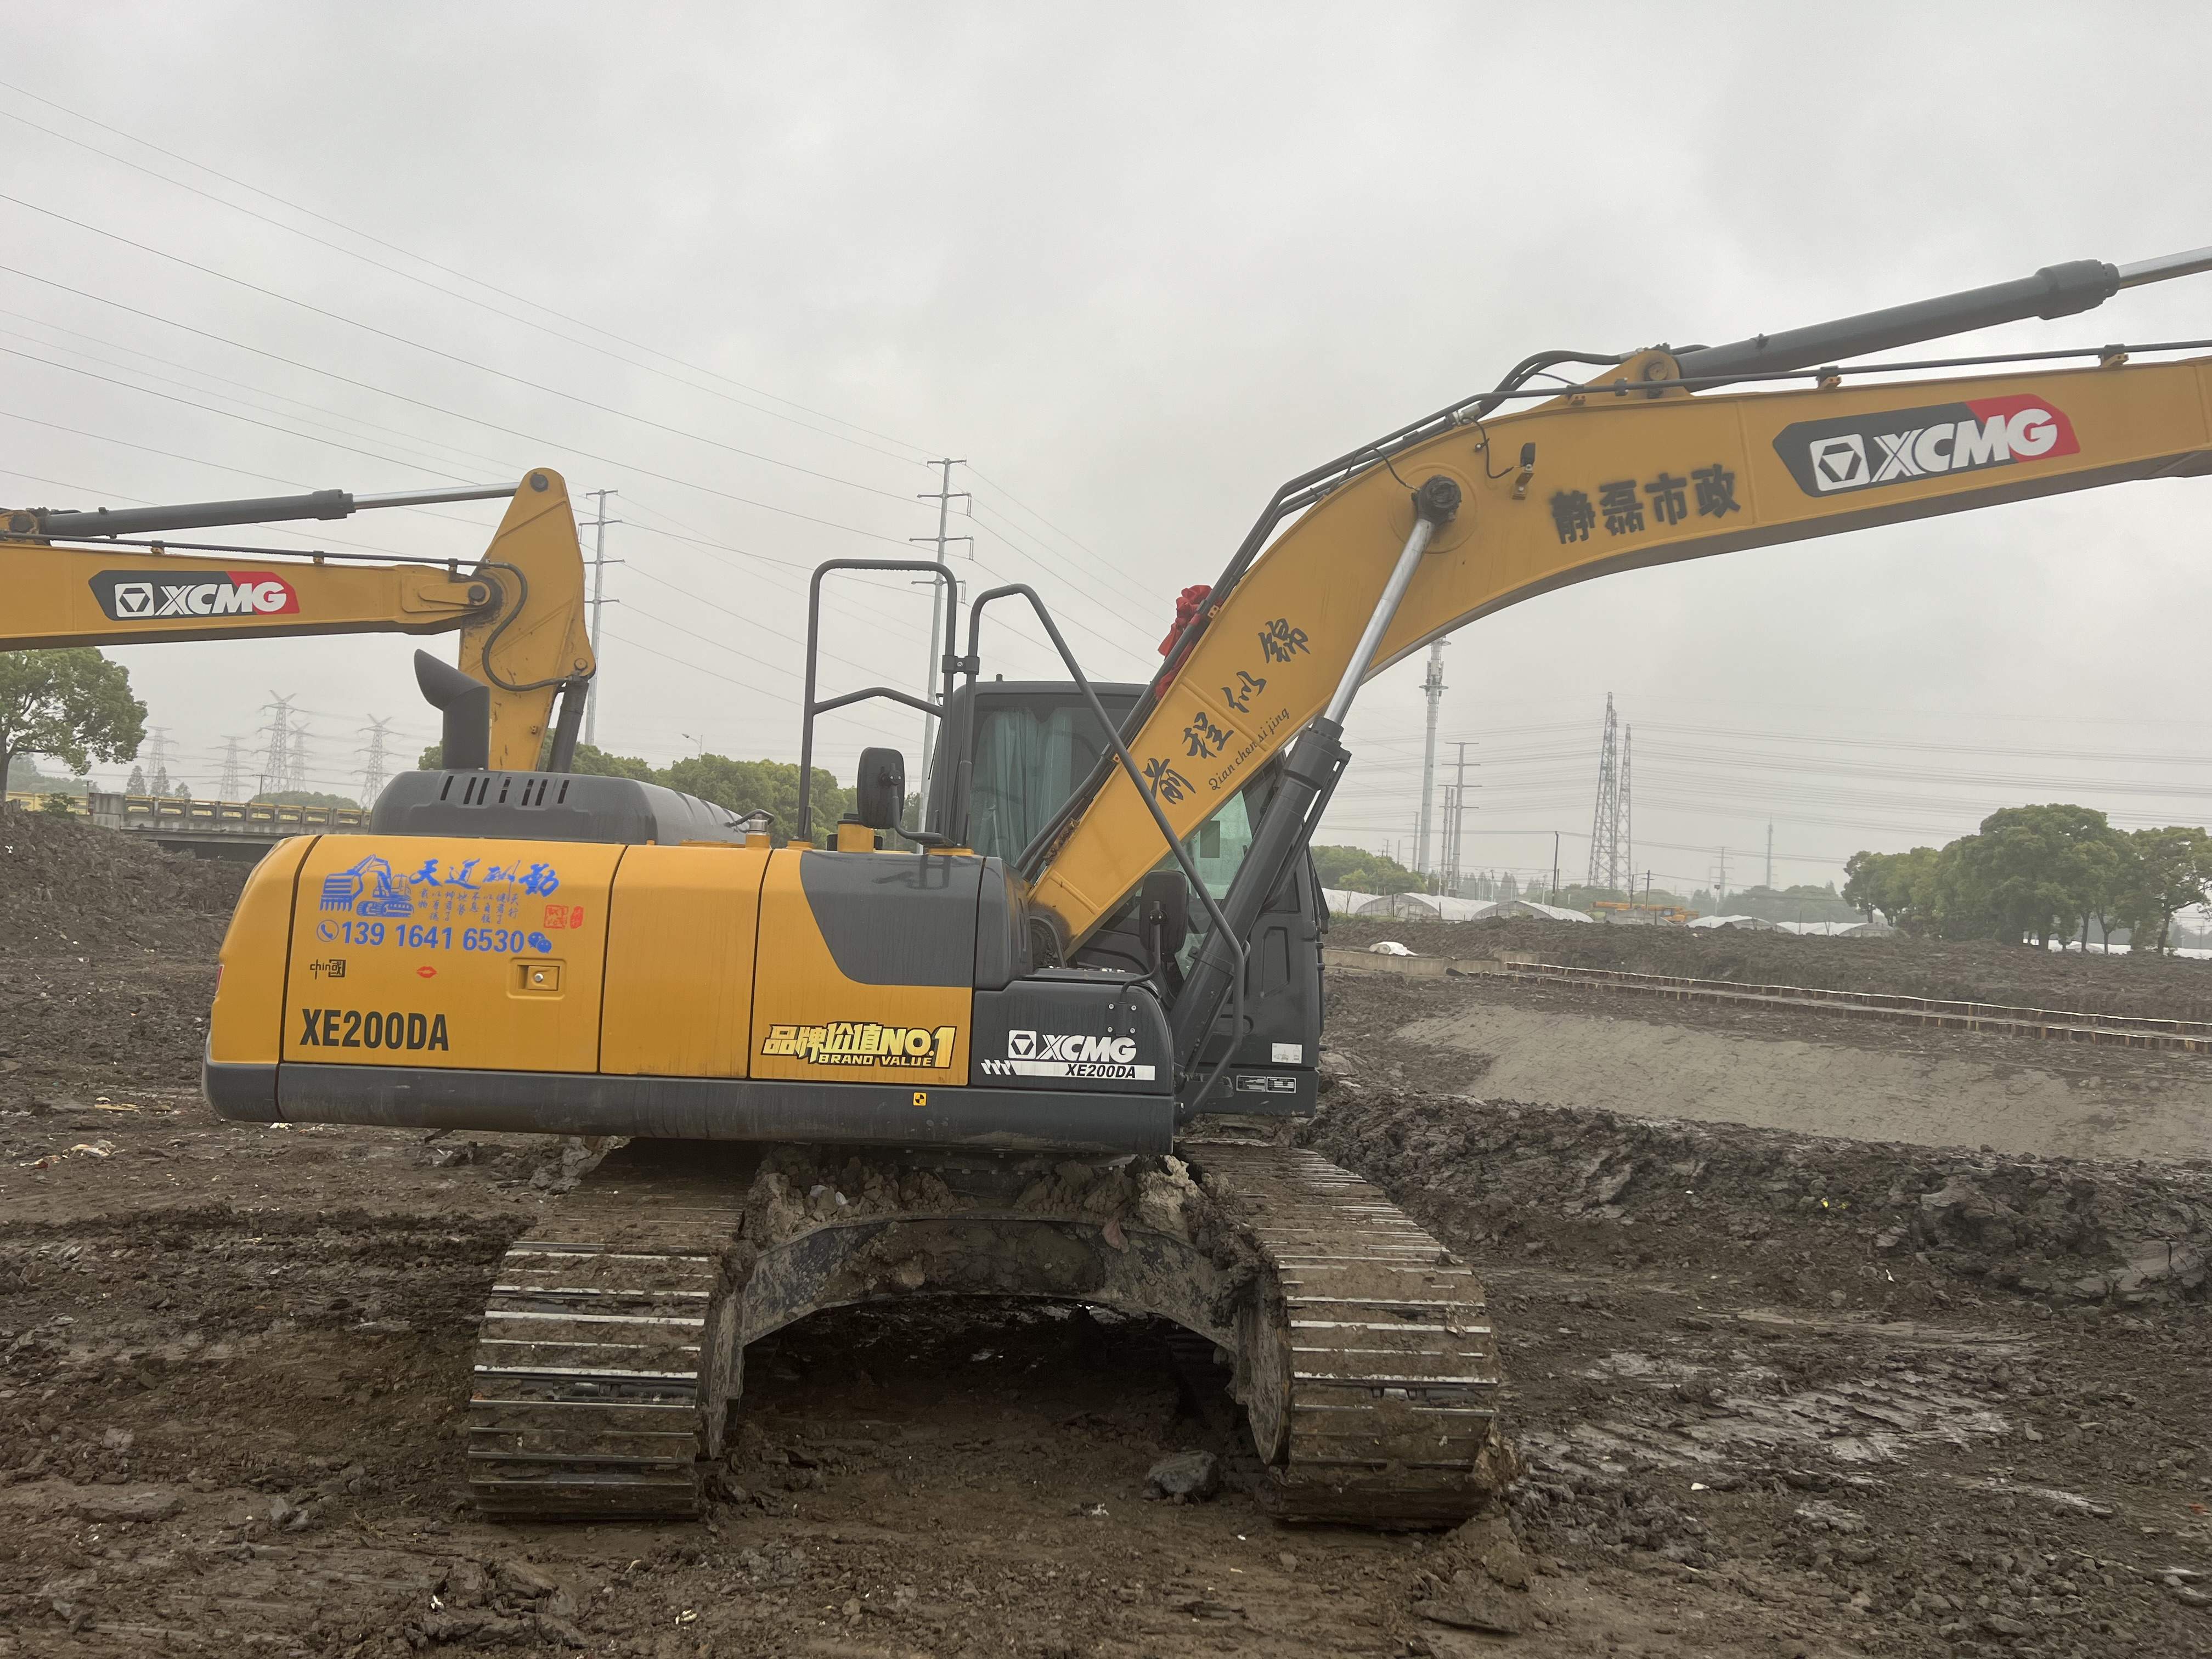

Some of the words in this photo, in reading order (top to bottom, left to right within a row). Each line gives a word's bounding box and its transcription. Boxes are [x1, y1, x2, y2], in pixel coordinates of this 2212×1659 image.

[1871, 408, 2057, 482] XCMG
[1550, 464, 1741, 544] 静磊市政
[155, 582, 287, 616] XCMG
[1235, 741, 1257, 766] chen
[342, 921, 385, 946] 139
[396, 924, 452, 950] 1641
[463, 927, 524, 953] 6530
[300, 1008, 449, 1051] XE200DA
[819, 1054, 873, 1065] BRAND
[882, 1056, 932, 1066] VALUE
[1036, 1034, 1137, 1063] XCMG
[1065, 1063, 1136, 1079] XE200DA
